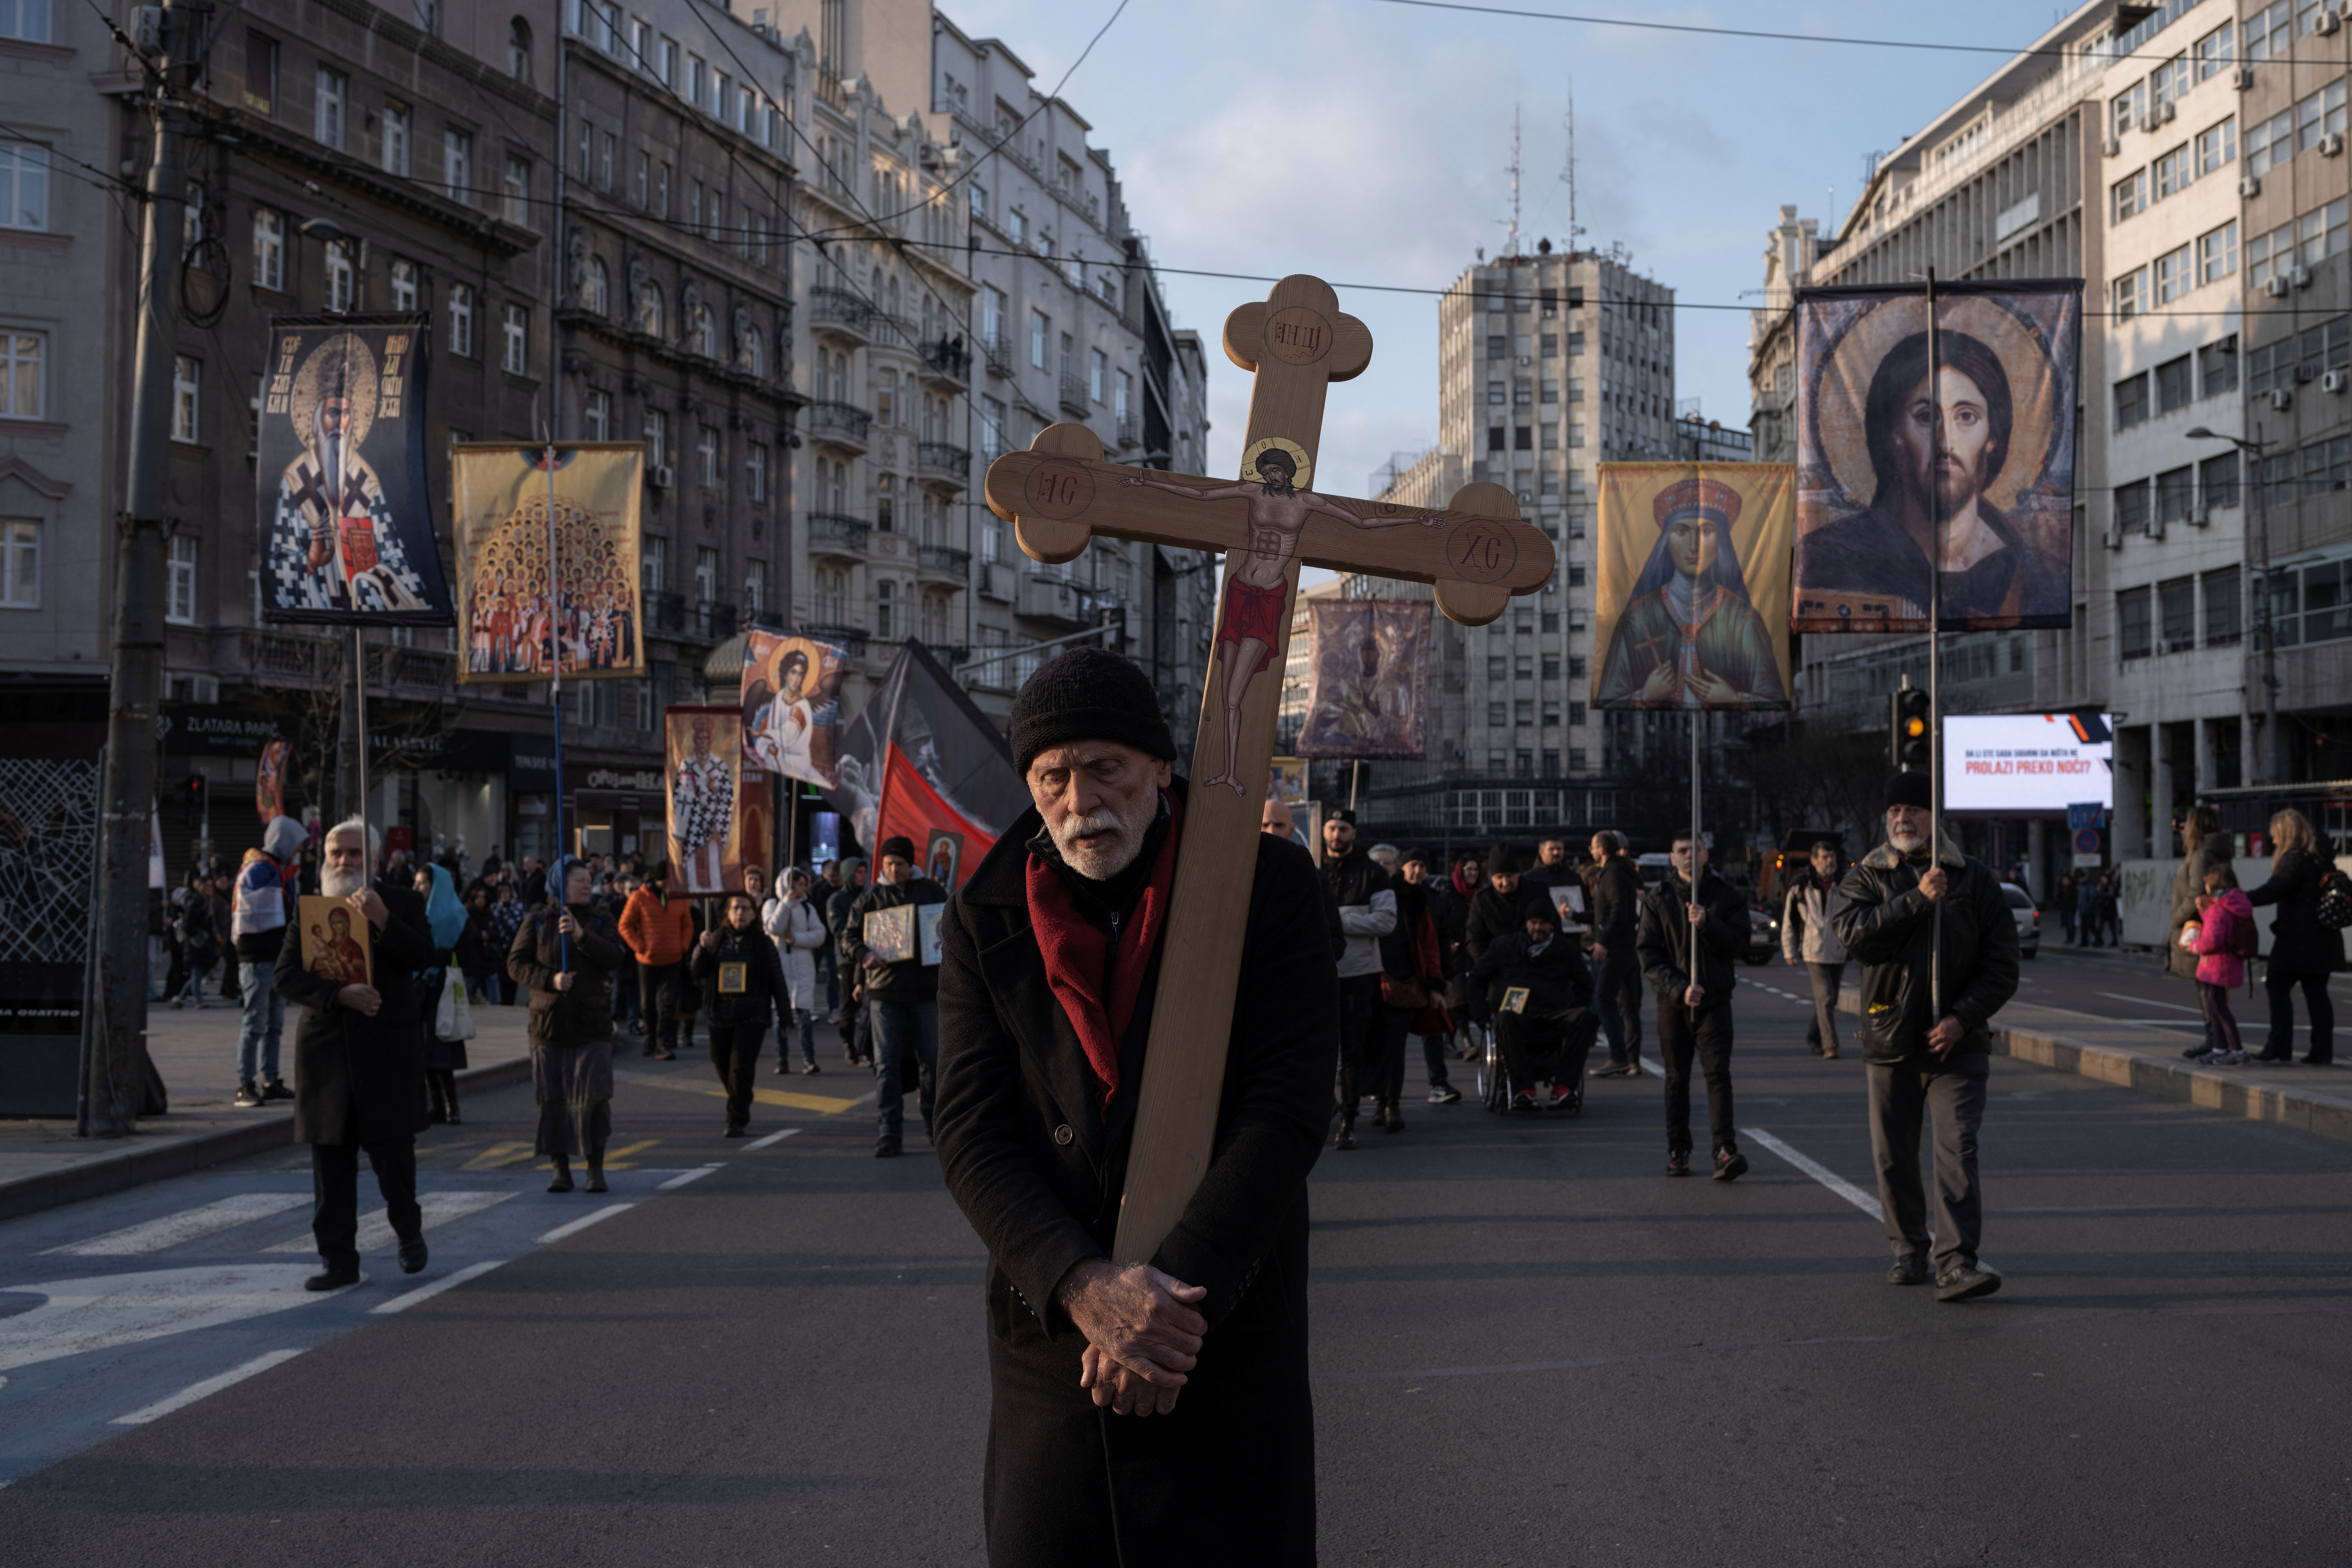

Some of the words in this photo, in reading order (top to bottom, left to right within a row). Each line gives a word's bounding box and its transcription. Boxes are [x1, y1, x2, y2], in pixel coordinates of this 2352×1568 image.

[187, 716, 242, 734] ZLATARA
[1965, 760, 2013, 774] PROLAZI
[2016, 760, 2054, 774] PREKO
[2057, 757, 2091, 774] NOĆI?
[17, 1009, 81, 1017] QUATTRO
